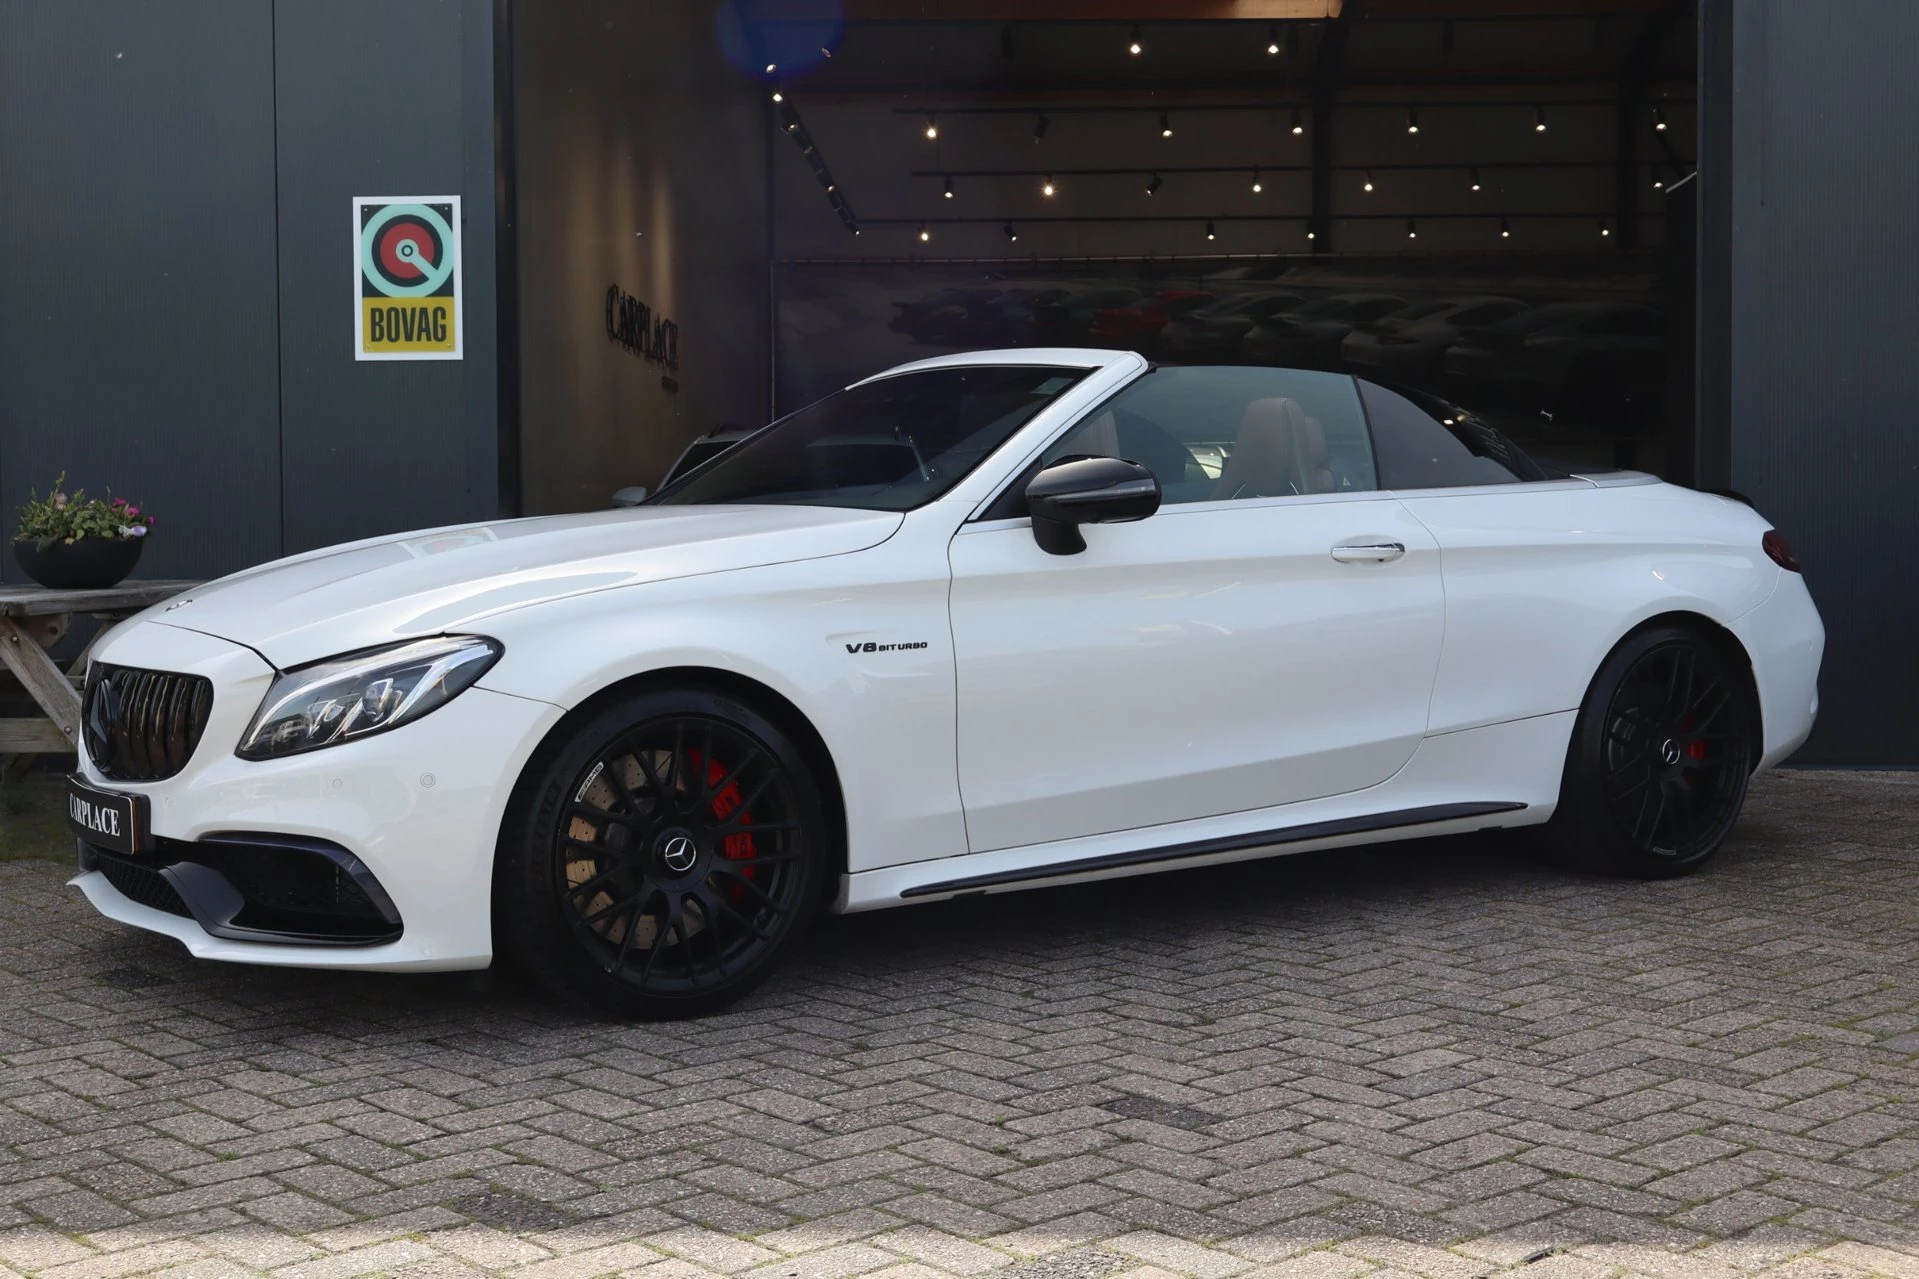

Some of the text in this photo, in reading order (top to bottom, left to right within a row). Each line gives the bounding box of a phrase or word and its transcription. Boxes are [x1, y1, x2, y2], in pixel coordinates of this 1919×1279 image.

[370, 306, 447, 343] BOVAG
[845, 641, 928, 654] V8 BITURBO
[69, 792, 120, 837] CARPLACE
